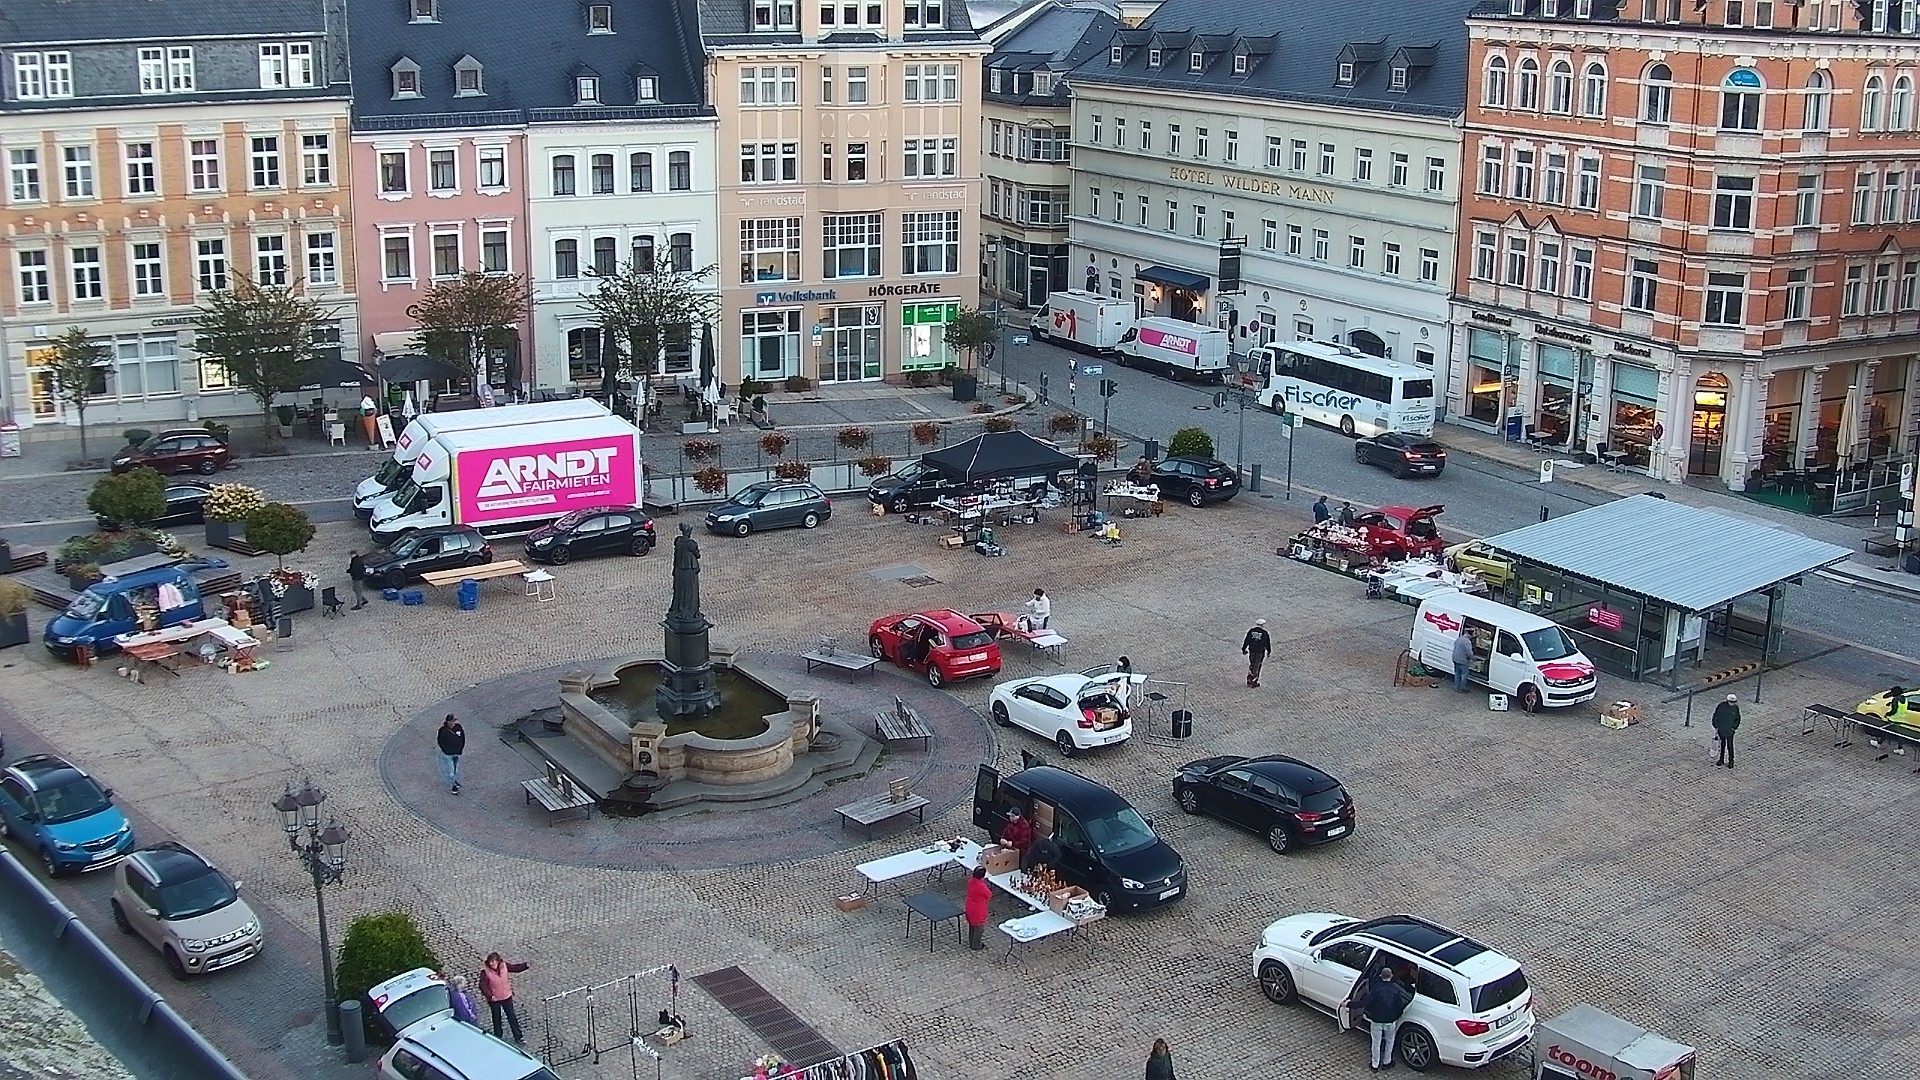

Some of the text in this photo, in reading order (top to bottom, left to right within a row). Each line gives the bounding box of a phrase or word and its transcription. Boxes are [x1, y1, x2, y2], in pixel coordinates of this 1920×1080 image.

[922, 188, 966, 200] randstad
[1169, 167, 1335, 205] HOTEL WILDER MANN
[758, 194, 805, 206] randstad
[778, 289, 836, 302] Volksbank
[868, 283, 941, 297] HÖRGERÄTE
[1160, 334, 1192, 349] ARNDT
[1284, 384, 1362, 411] Fischer
[477, 446, 618, 498] ARNDT
[522, 473, 610, 493] FAIRMIETEN
[1548, 1043, 1617, 1080] toom
